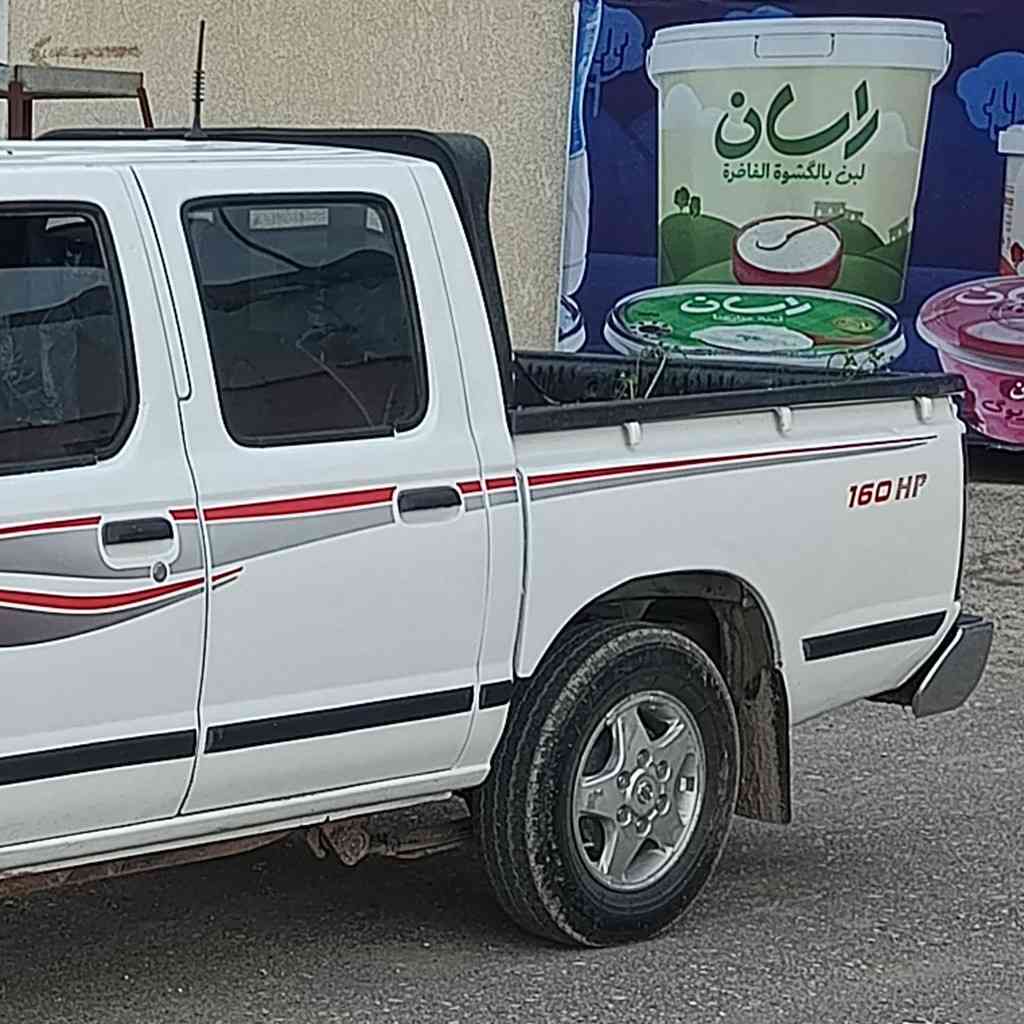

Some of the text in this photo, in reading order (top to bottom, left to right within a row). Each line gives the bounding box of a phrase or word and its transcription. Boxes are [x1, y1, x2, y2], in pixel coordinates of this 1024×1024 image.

[714, 79, 880, 160] راسان
[722, 162, 770, 183] الفاخرة
[834, 162, 866, 185] لبن
[847, 472, 928, 508] 160 HP
